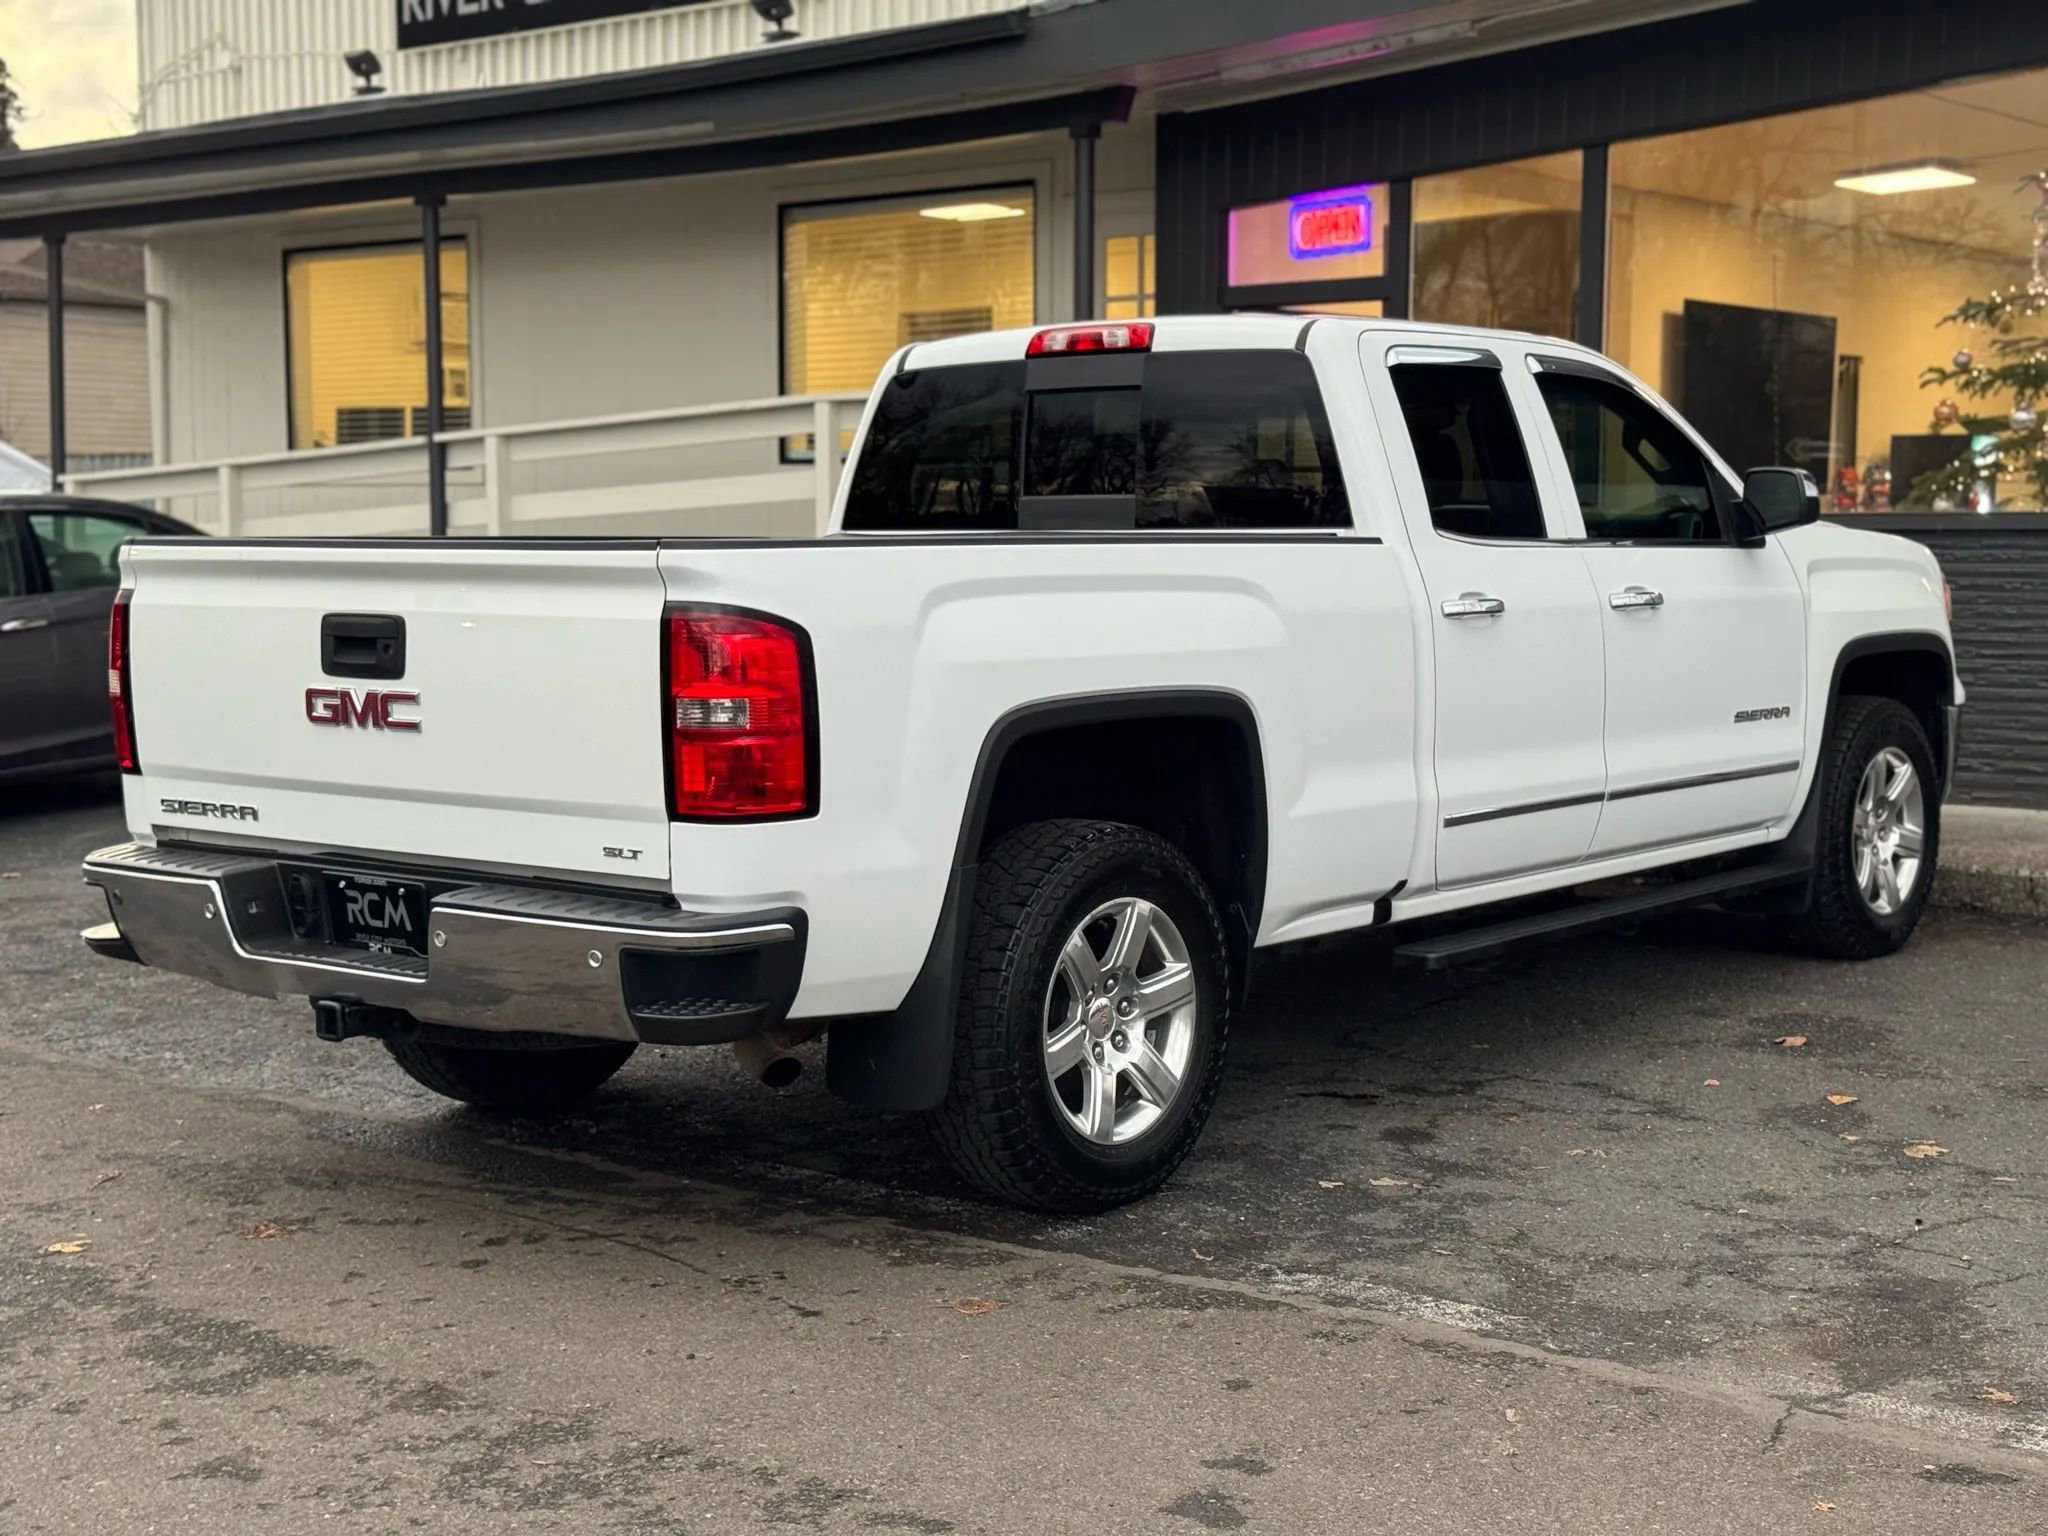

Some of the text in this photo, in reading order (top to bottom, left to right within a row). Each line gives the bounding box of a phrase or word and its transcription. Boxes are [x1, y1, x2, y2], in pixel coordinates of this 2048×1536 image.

[1296, 204, 1366, 250] OPEN
[305, 687, 422, 732] GMC
[1734, 706, 1791, 724] SIERRA
[160, 799, 259, 821] SIERRA
[602, 846, 643, 861] SLT
[344, 889, 413, 932] RCM
